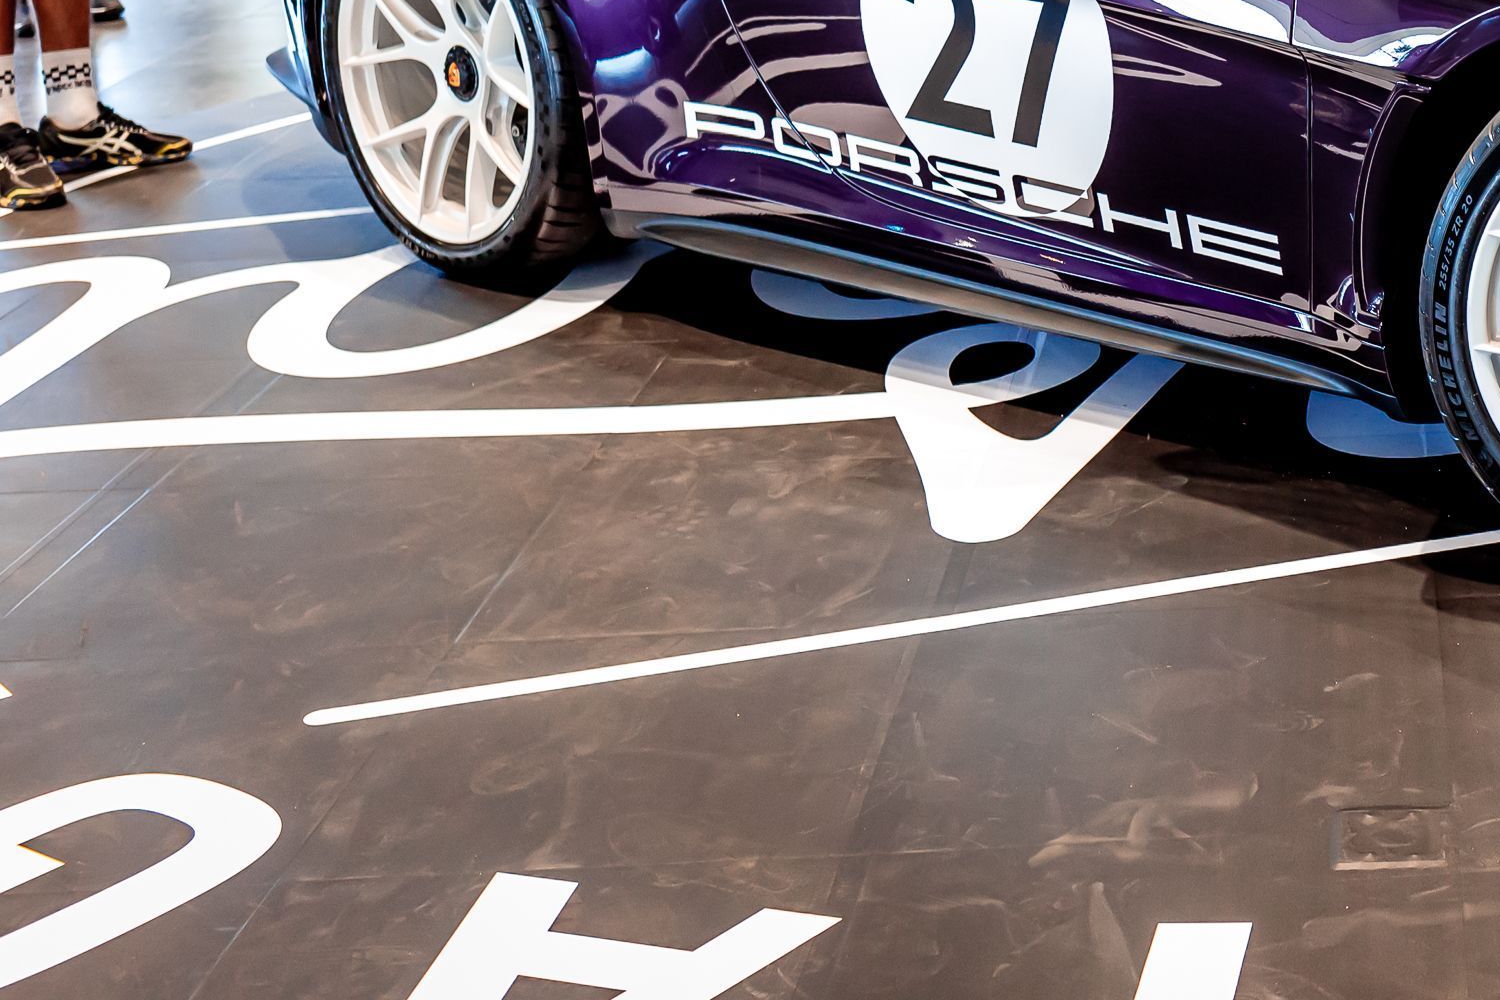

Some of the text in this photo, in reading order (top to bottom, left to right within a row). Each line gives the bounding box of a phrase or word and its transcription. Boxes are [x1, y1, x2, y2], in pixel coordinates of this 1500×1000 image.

[683, 100, 1283, 276] PORSCHE
[1434, 194, 1481, 443] MICHELIN 255/35 ZR 20
